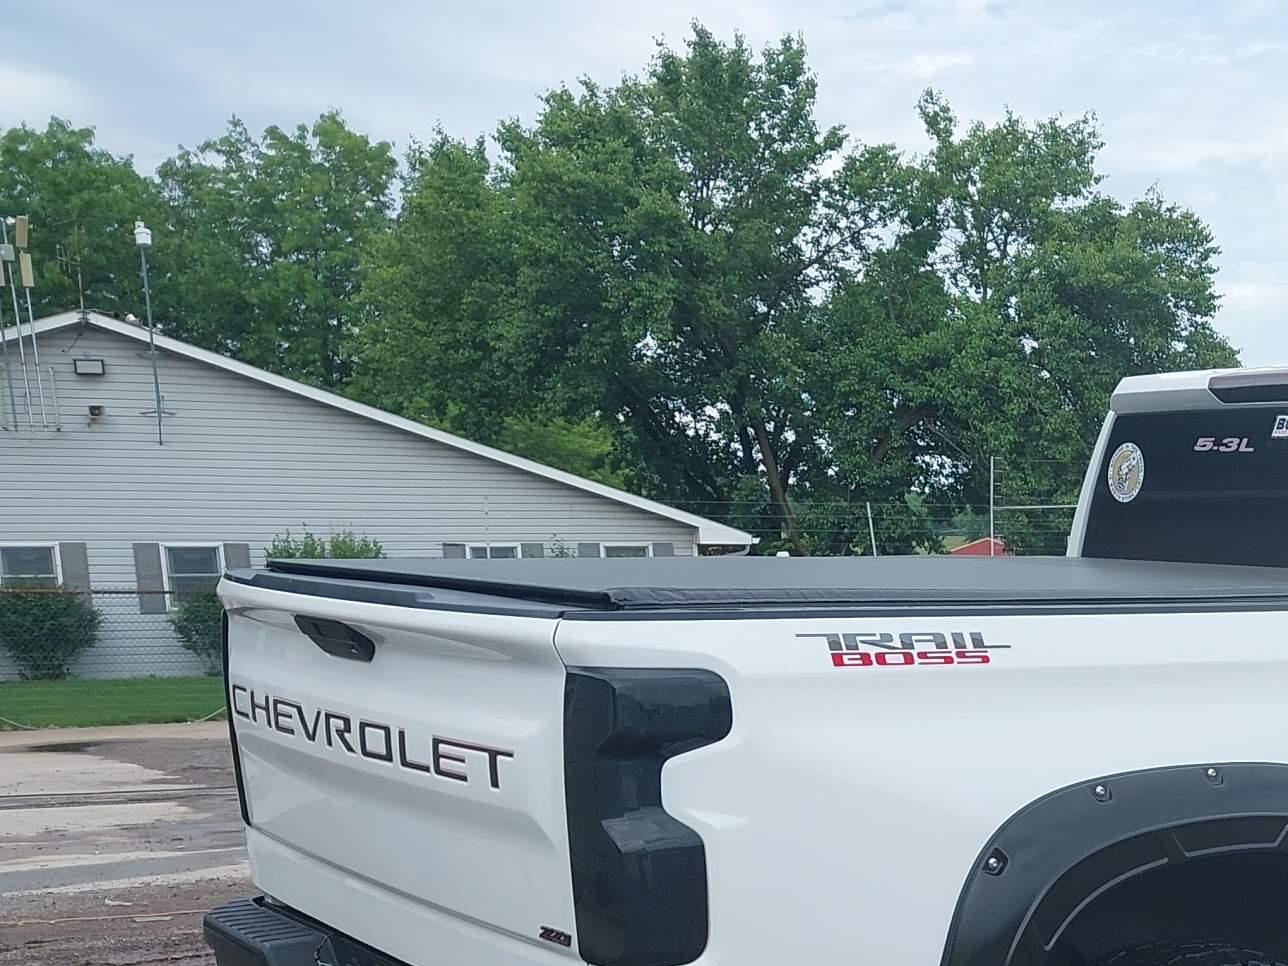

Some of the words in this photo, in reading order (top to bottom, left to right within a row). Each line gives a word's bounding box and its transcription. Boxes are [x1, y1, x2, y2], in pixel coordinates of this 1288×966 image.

[1193, 436, 1255, 453] 5.3L
[794, 631, 1013, 651] TRAIL
[830, 650, 992, 668] BOSS
[232, 684, 515, 790] CHEVROLET
